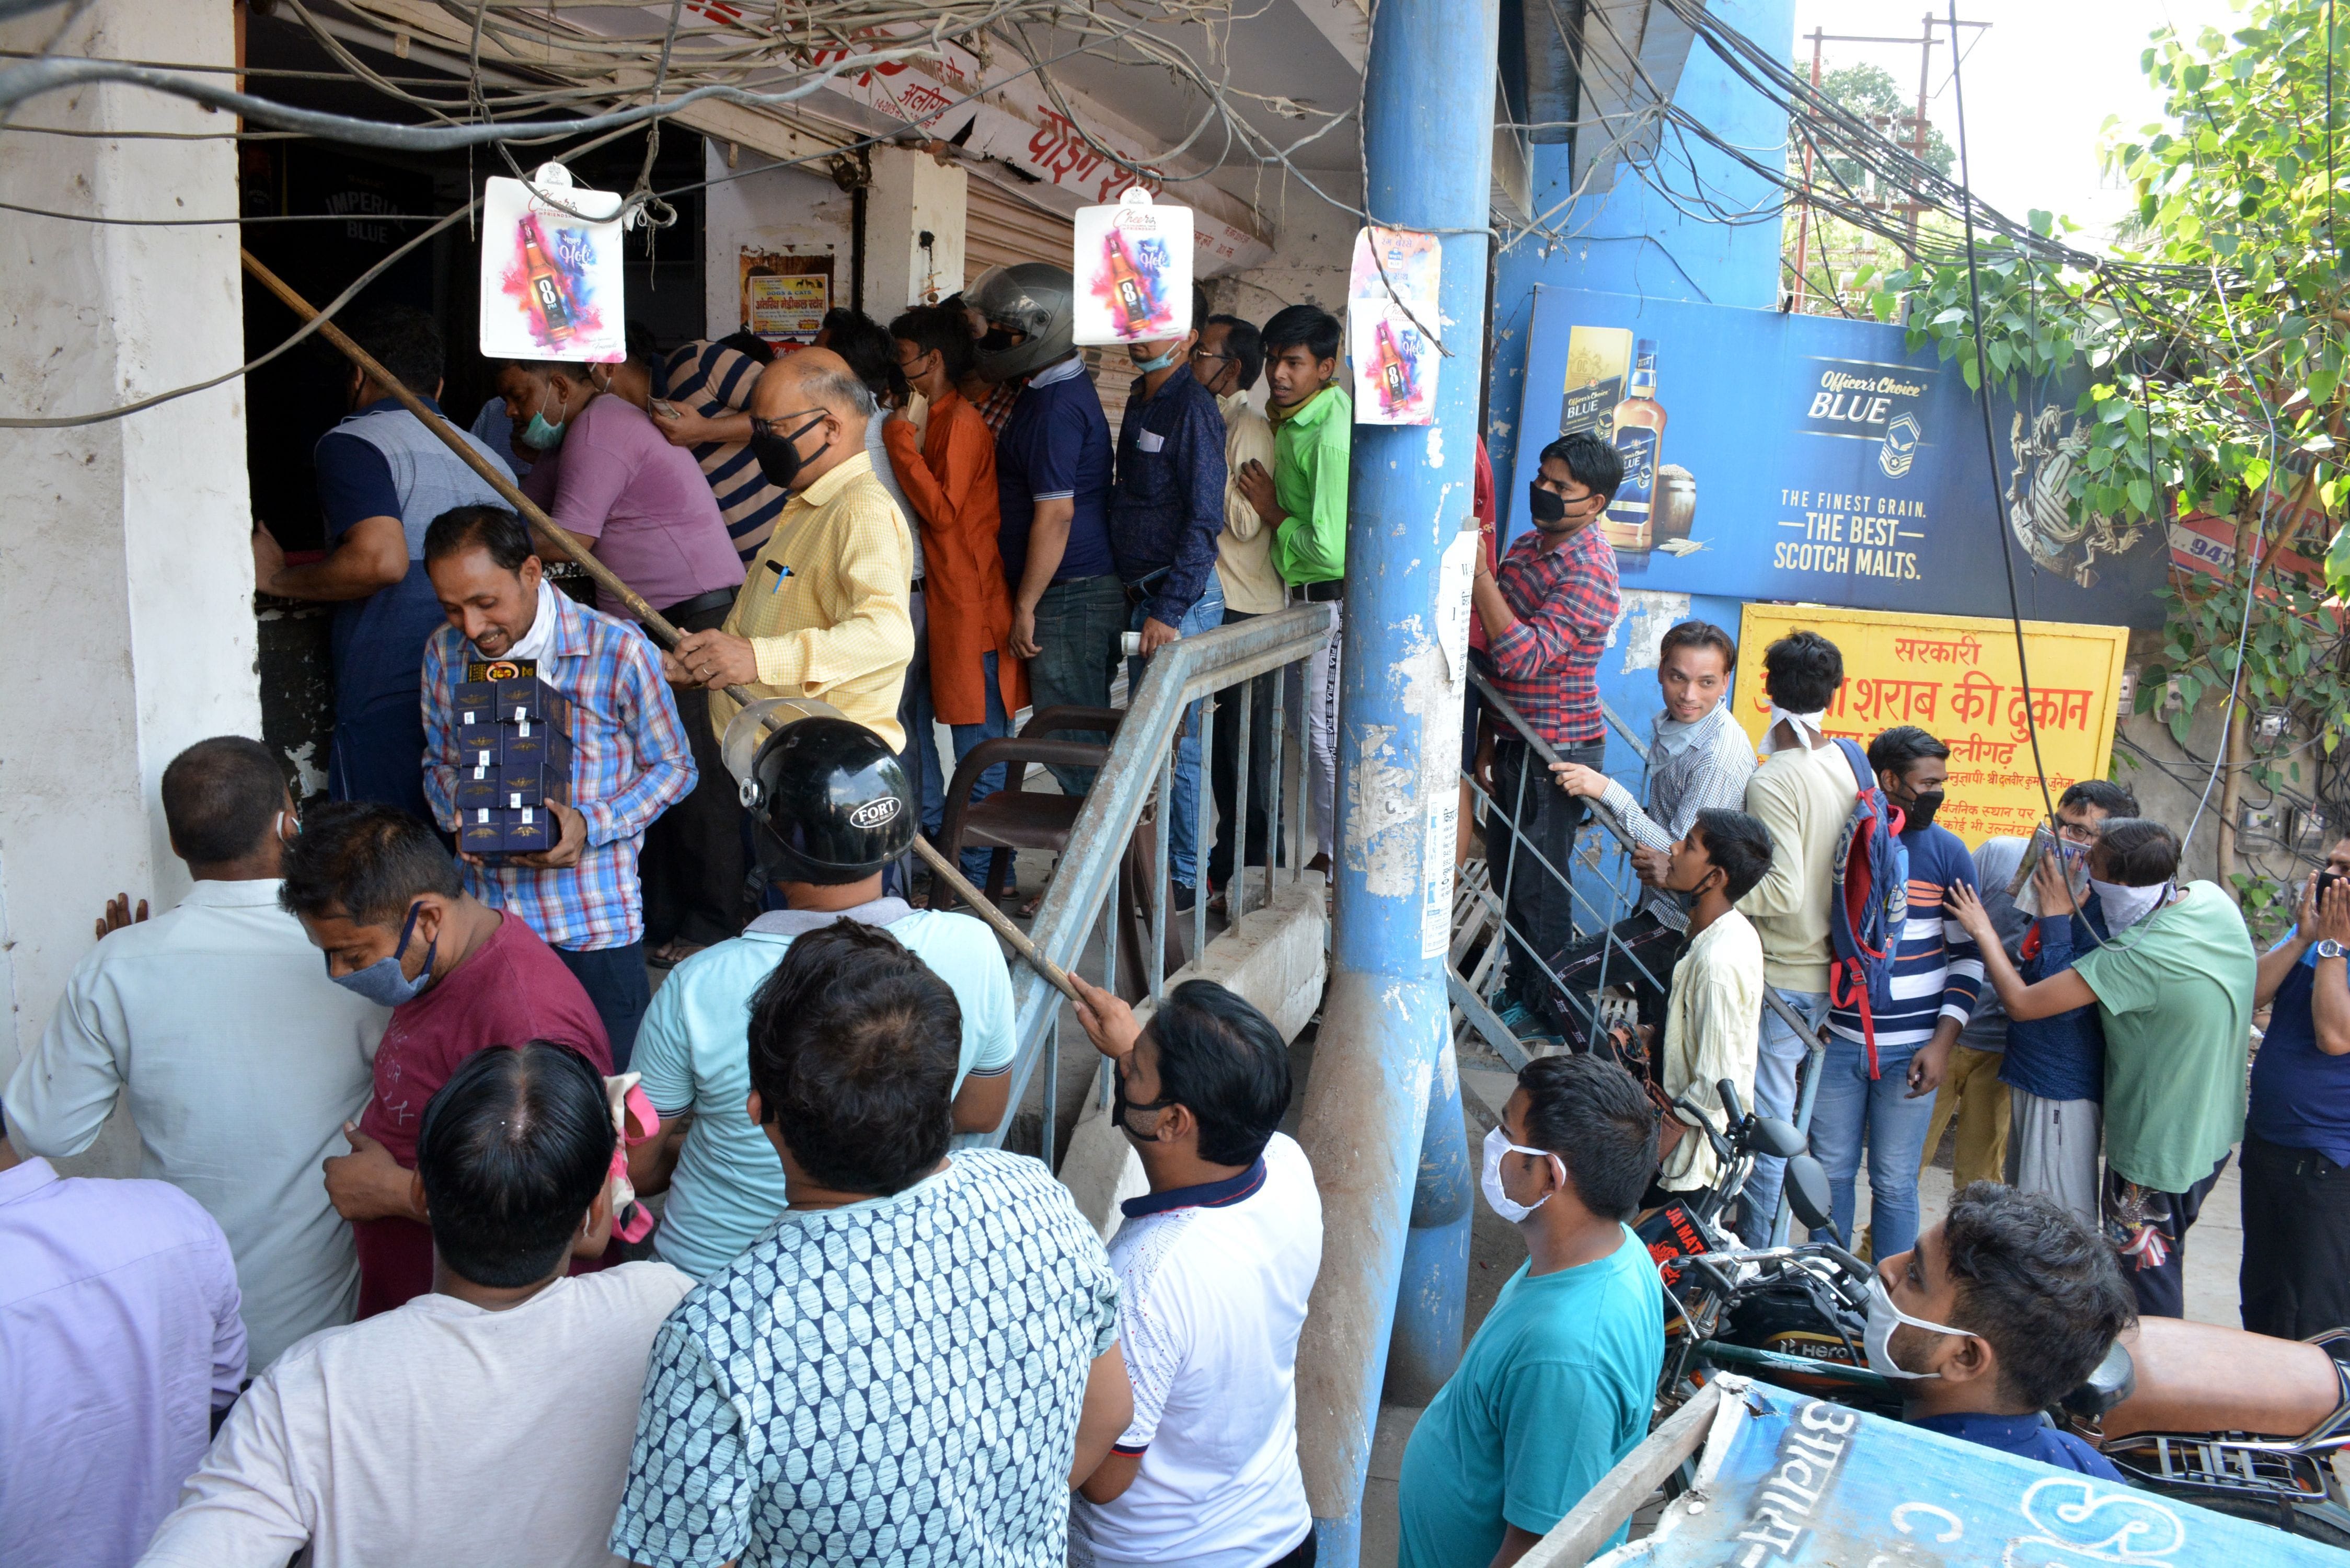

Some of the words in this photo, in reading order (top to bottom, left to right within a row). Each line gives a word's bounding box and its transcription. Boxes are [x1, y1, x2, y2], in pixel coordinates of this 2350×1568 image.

[1113, 209, 1156, 228] Cheers
[347, 220, 389, 245] BLUE
[559, 244, 593, 269] Holi
[1140, 251, 1166, 271] Holi
[539, 279, 556, 305] 8
[1122, 282, 1137, 302] 8
[1402, 341, 1423, 355] Holi
[1388, 366, 1399, 385] 8
[1821, 370, 1876, 392] Officer's
[1877, 376, 1921, 397] Choice
[1567, 399, 1598, 419] BLUE
[1807, 392, 1892, 424] BLUE
[1625, 456, 1641, 469] LUE
[1781, 489, 1810, 507] THE
[1817, 492, 1871, 512] FINEST
[1877, 498, 1927, 518] GRAIN.
[1773, 541, 1850, 573] SCOTCH
[1854, 548, 1921, 580] MALTS.
[1329, 647, 1337, 666] FILA
[1895, 635, 1983, 666] सरकारी
[1853, 677, 1943, 723] शराब
[1951, 671, 2005, 727] की
[2008, 686, 2094, 743] दुकान
[1987, 770, 1998, 786] श्री
[858, 800, 894, 822] FORT
[863, 817, 880, 826] SPECIAL
[880, 811, 894, 821] QUALITY
[1939, 799, 1978, 815] र्वजनिक
[1983, 805, 2014, 817] स्थान
[2017, 808, 2035, 820] पर
[1943, 817, 1967, 834] कोई
[1971, 819, 1984, 832] भी
[1665, 1207, 1686, 1228] JAI
[1803, 1344, 1849, 1358] Hero
